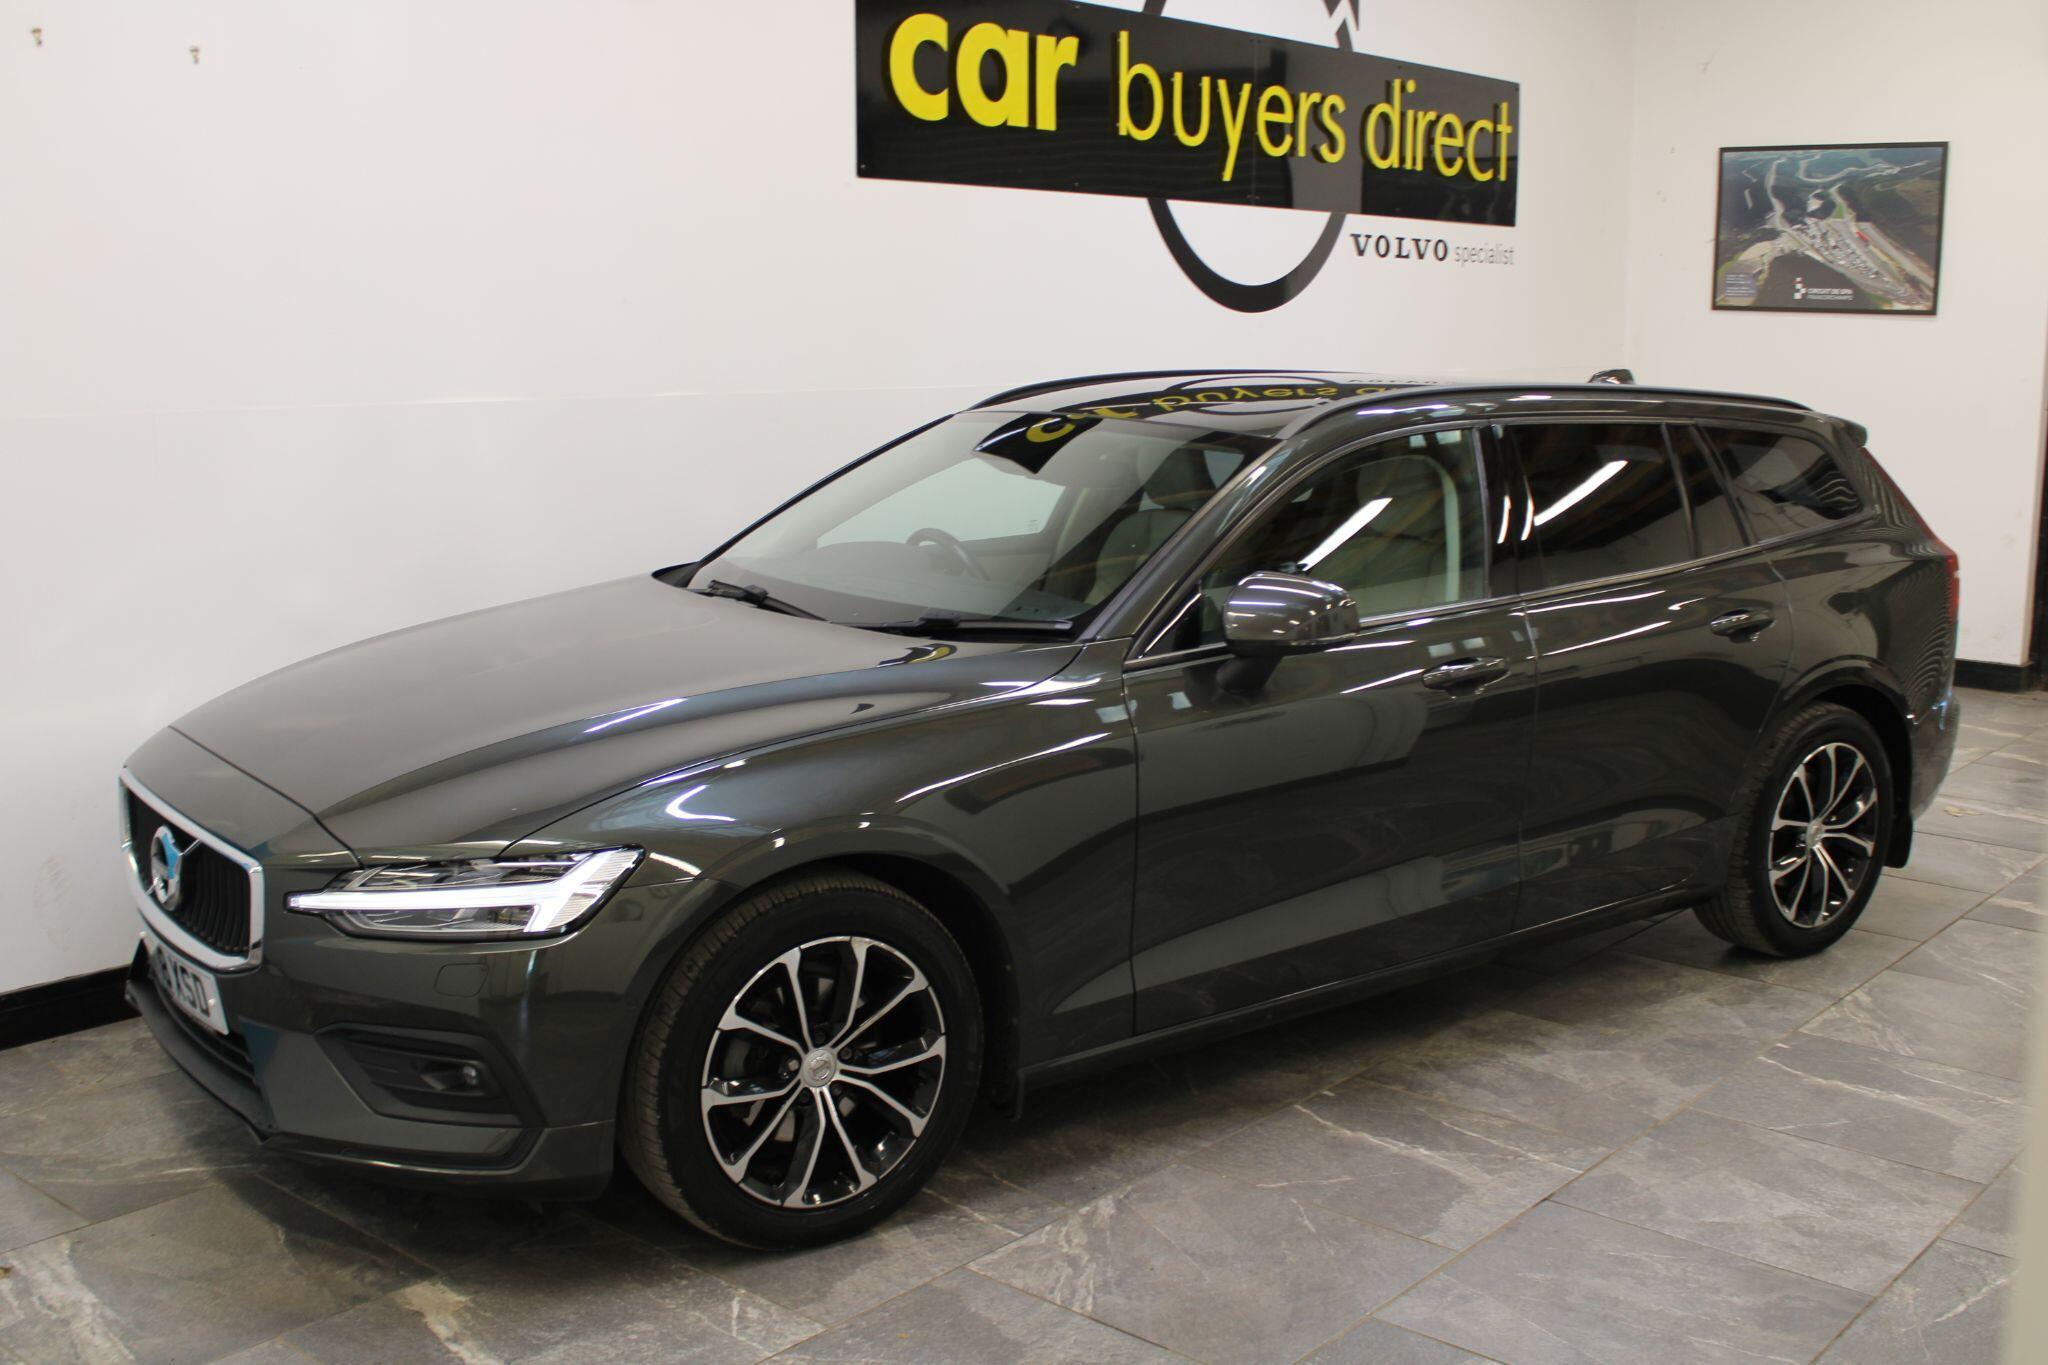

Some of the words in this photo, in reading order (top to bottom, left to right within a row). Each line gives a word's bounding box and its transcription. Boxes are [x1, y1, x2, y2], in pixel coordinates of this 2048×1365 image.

[888, 13, 1080, 132] car
[1117, 31, 1347, 182] buyers
[1363, 79, 1514, 182] direct
[1349, 233, 1449, 262] VOLVO
[1454, 242, 1515, 268] specialist
